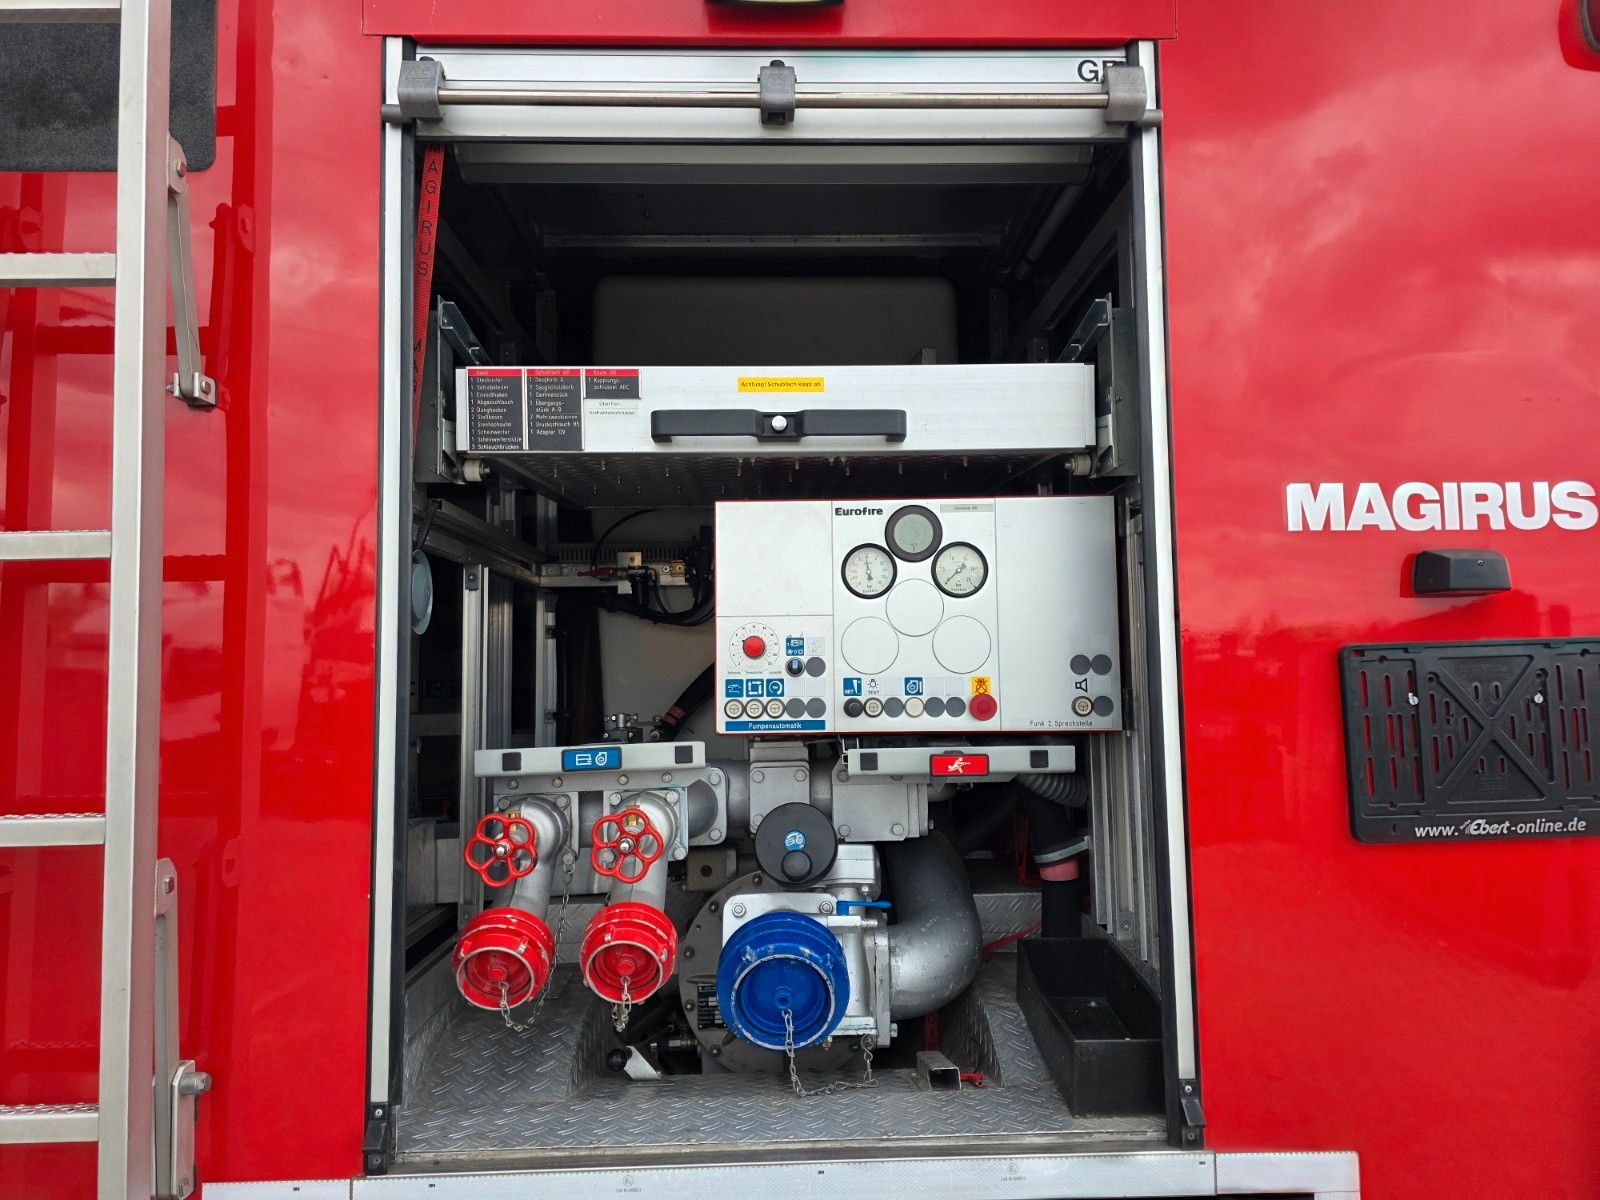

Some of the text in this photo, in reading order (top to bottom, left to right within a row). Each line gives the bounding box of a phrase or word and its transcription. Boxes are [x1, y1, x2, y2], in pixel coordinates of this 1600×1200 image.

[834, 506, 884, 517] Eurofire
[1286, 480, 1599, 532] MAGIRUS
[748, 722, 802, 731] Pumpenautomatik
